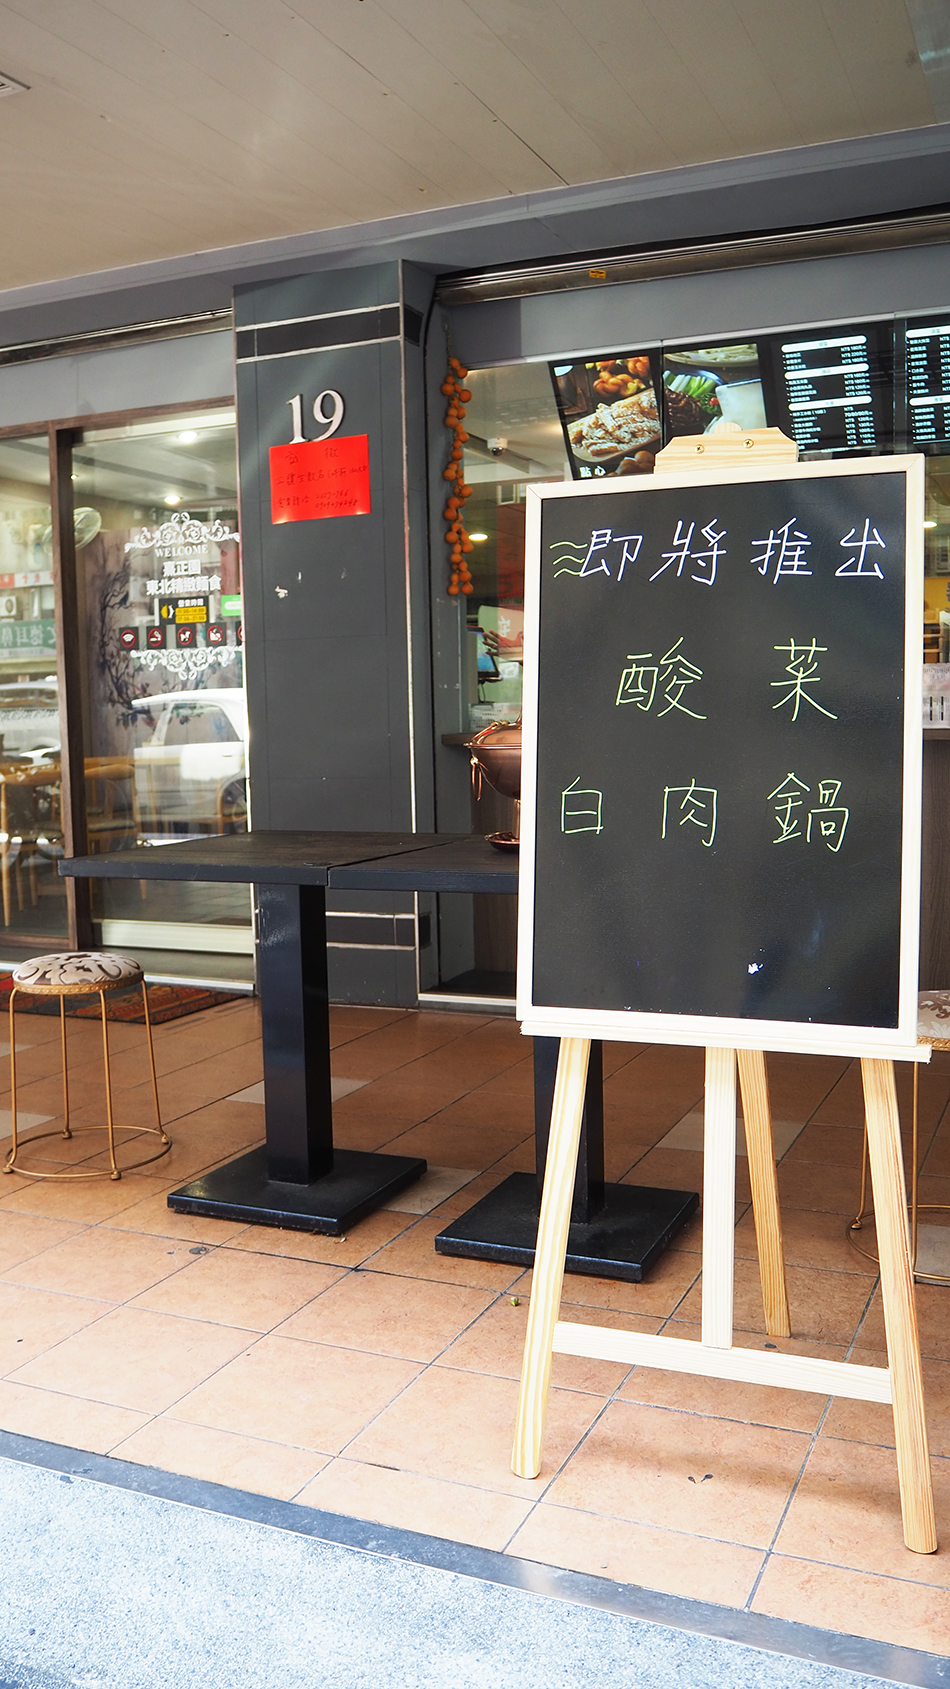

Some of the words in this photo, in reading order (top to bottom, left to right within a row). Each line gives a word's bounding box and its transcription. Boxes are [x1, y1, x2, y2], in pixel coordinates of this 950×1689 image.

[287, 390, 345, 444] 19
[579, 465, 606, 478] 點心
[154, 544, 209, 558] WELCOME
[580, 518, 886, 585] 即將推出
[616, 637, 837, 721] 酸菜
[562, 773, 848, 852] 白肉鍋
